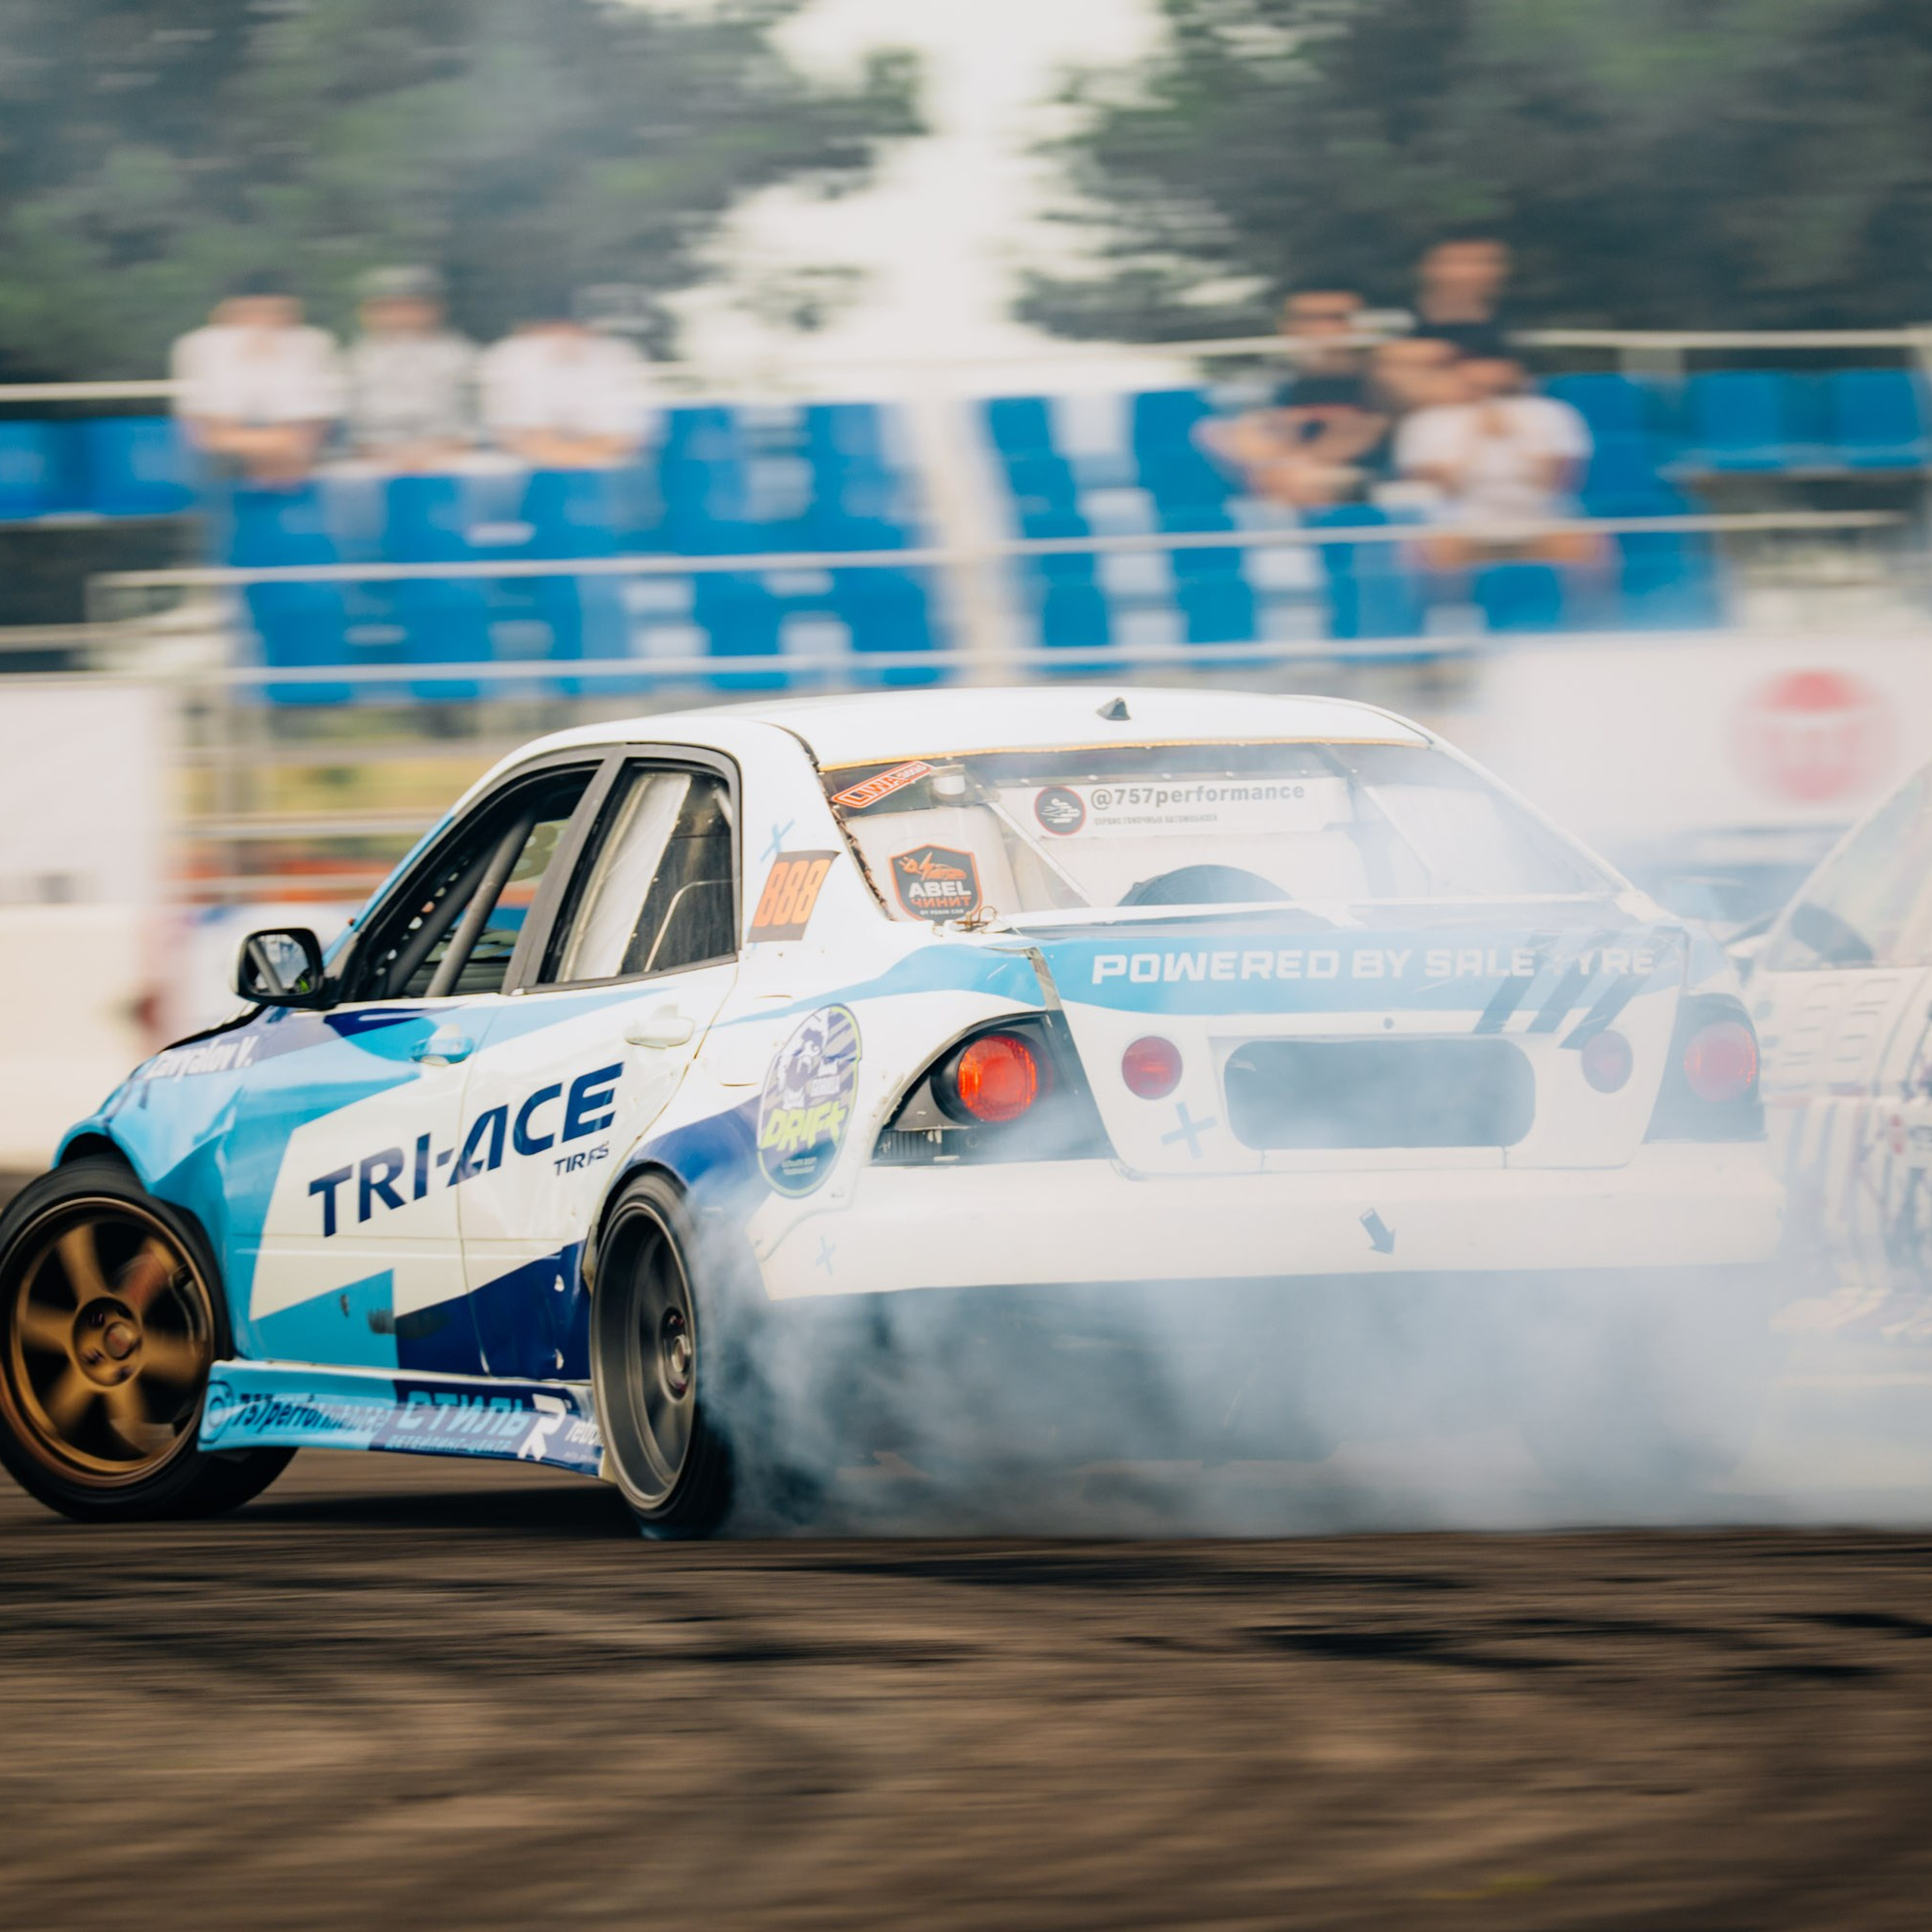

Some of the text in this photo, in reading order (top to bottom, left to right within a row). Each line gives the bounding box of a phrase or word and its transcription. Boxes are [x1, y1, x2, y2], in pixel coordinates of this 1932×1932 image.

[1091, 786, 1305, 811] @757performance
[753, 859, 832, 928] 888
[910, 896, 973, 909] ЧИНИТ
[1092, 949, 1341, 984] POWERED
[1351, 949, 1412, 979] BY
[1423, 947, 1536, 978] SALE
[308, 1061, 625, 1238] TRI-ACE
[396, 1390, 531, 1436] СТИЛЬ
